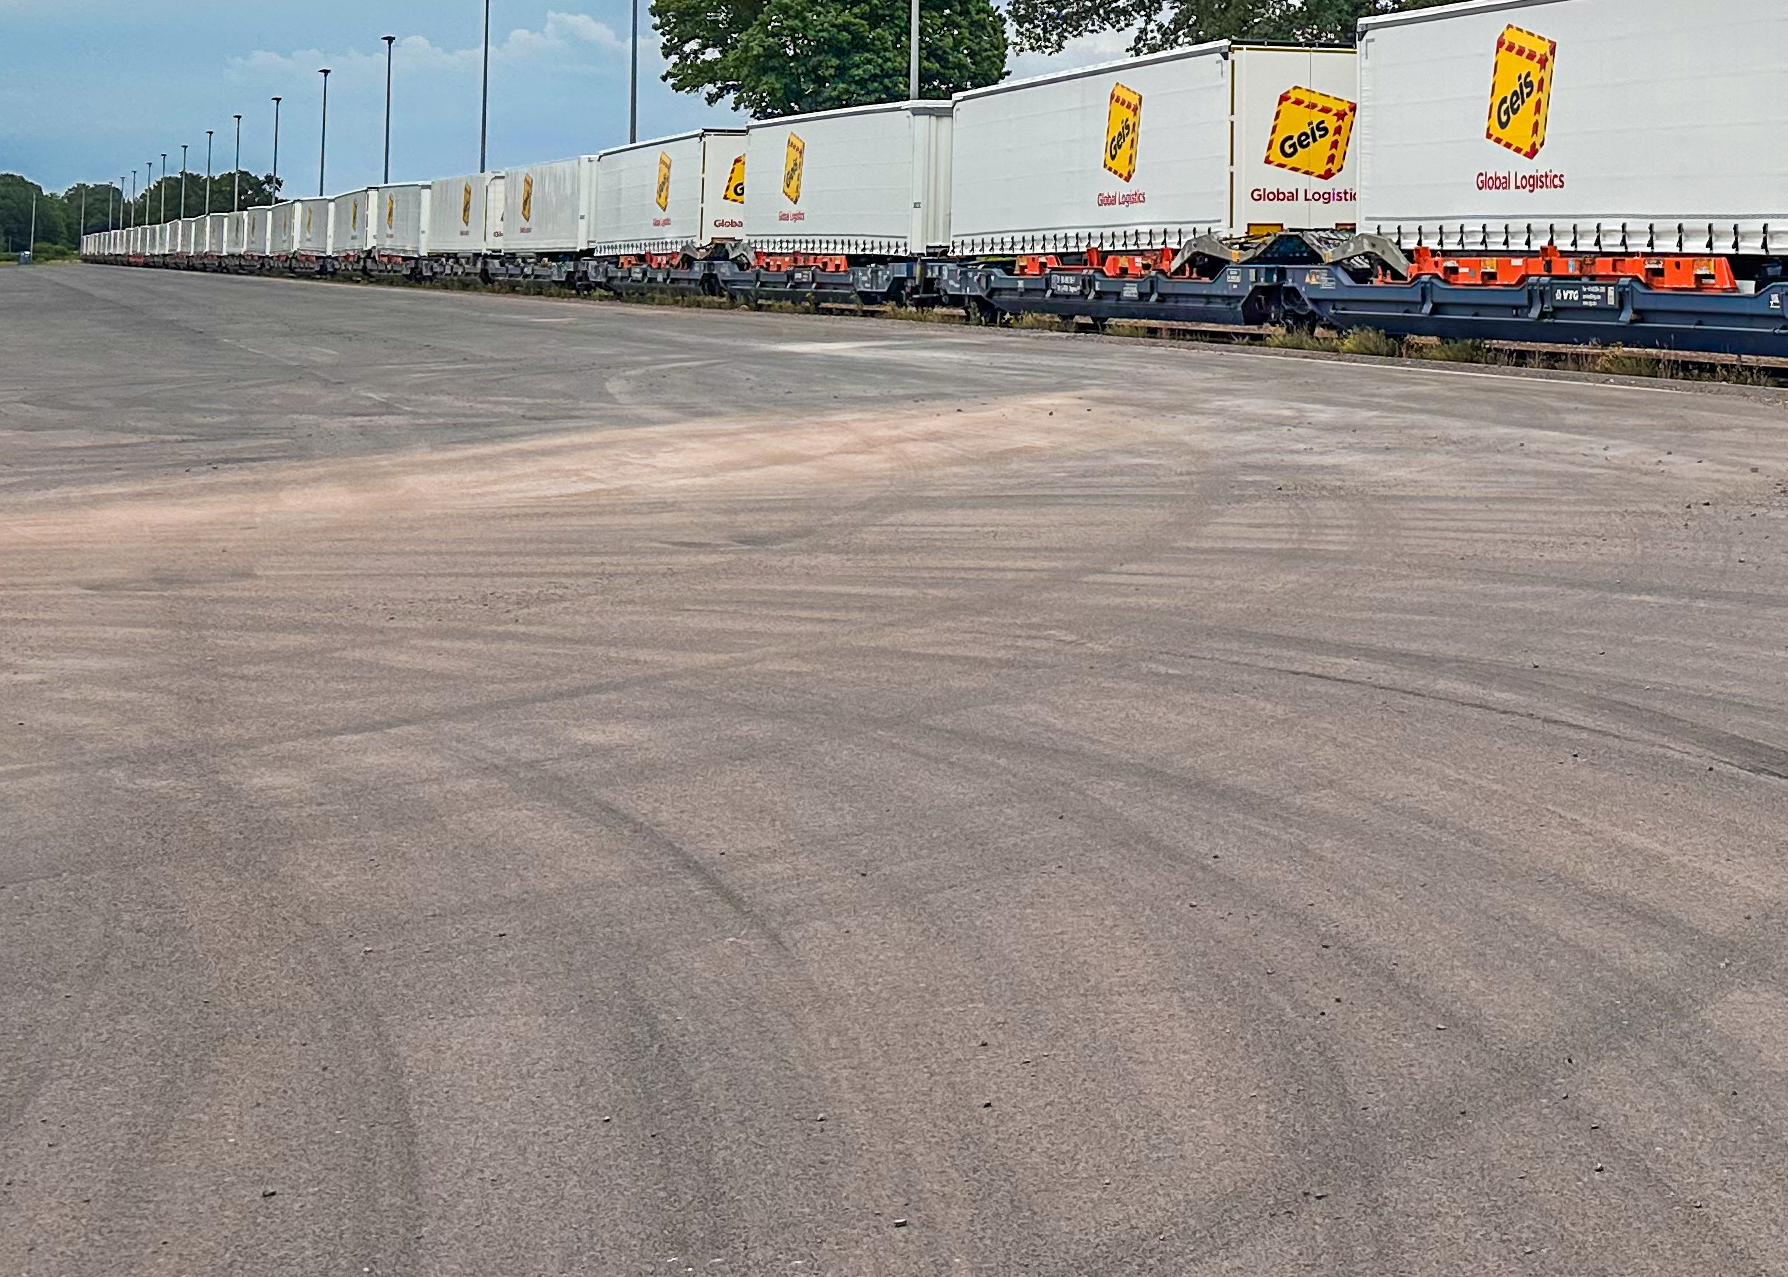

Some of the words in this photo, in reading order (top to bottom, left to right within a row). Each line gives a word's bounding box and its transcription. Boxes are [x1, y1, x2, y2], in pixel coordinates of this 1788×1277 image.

[1497, 71, 1534, 130] Geis
[1110, 117, 1130, 161] Geis
[1279, 120, 1329, 158] Geis
[1476, 171, 1511, 190] Global
[1514, 169, 1565, 193] Logistics
[1250, 188, 1299, 201] Global
[1304, 188, 1356, 204] Logisti
[713, 219, 743, 228] Globa
[1562, 289, 1579, 301] VTG
